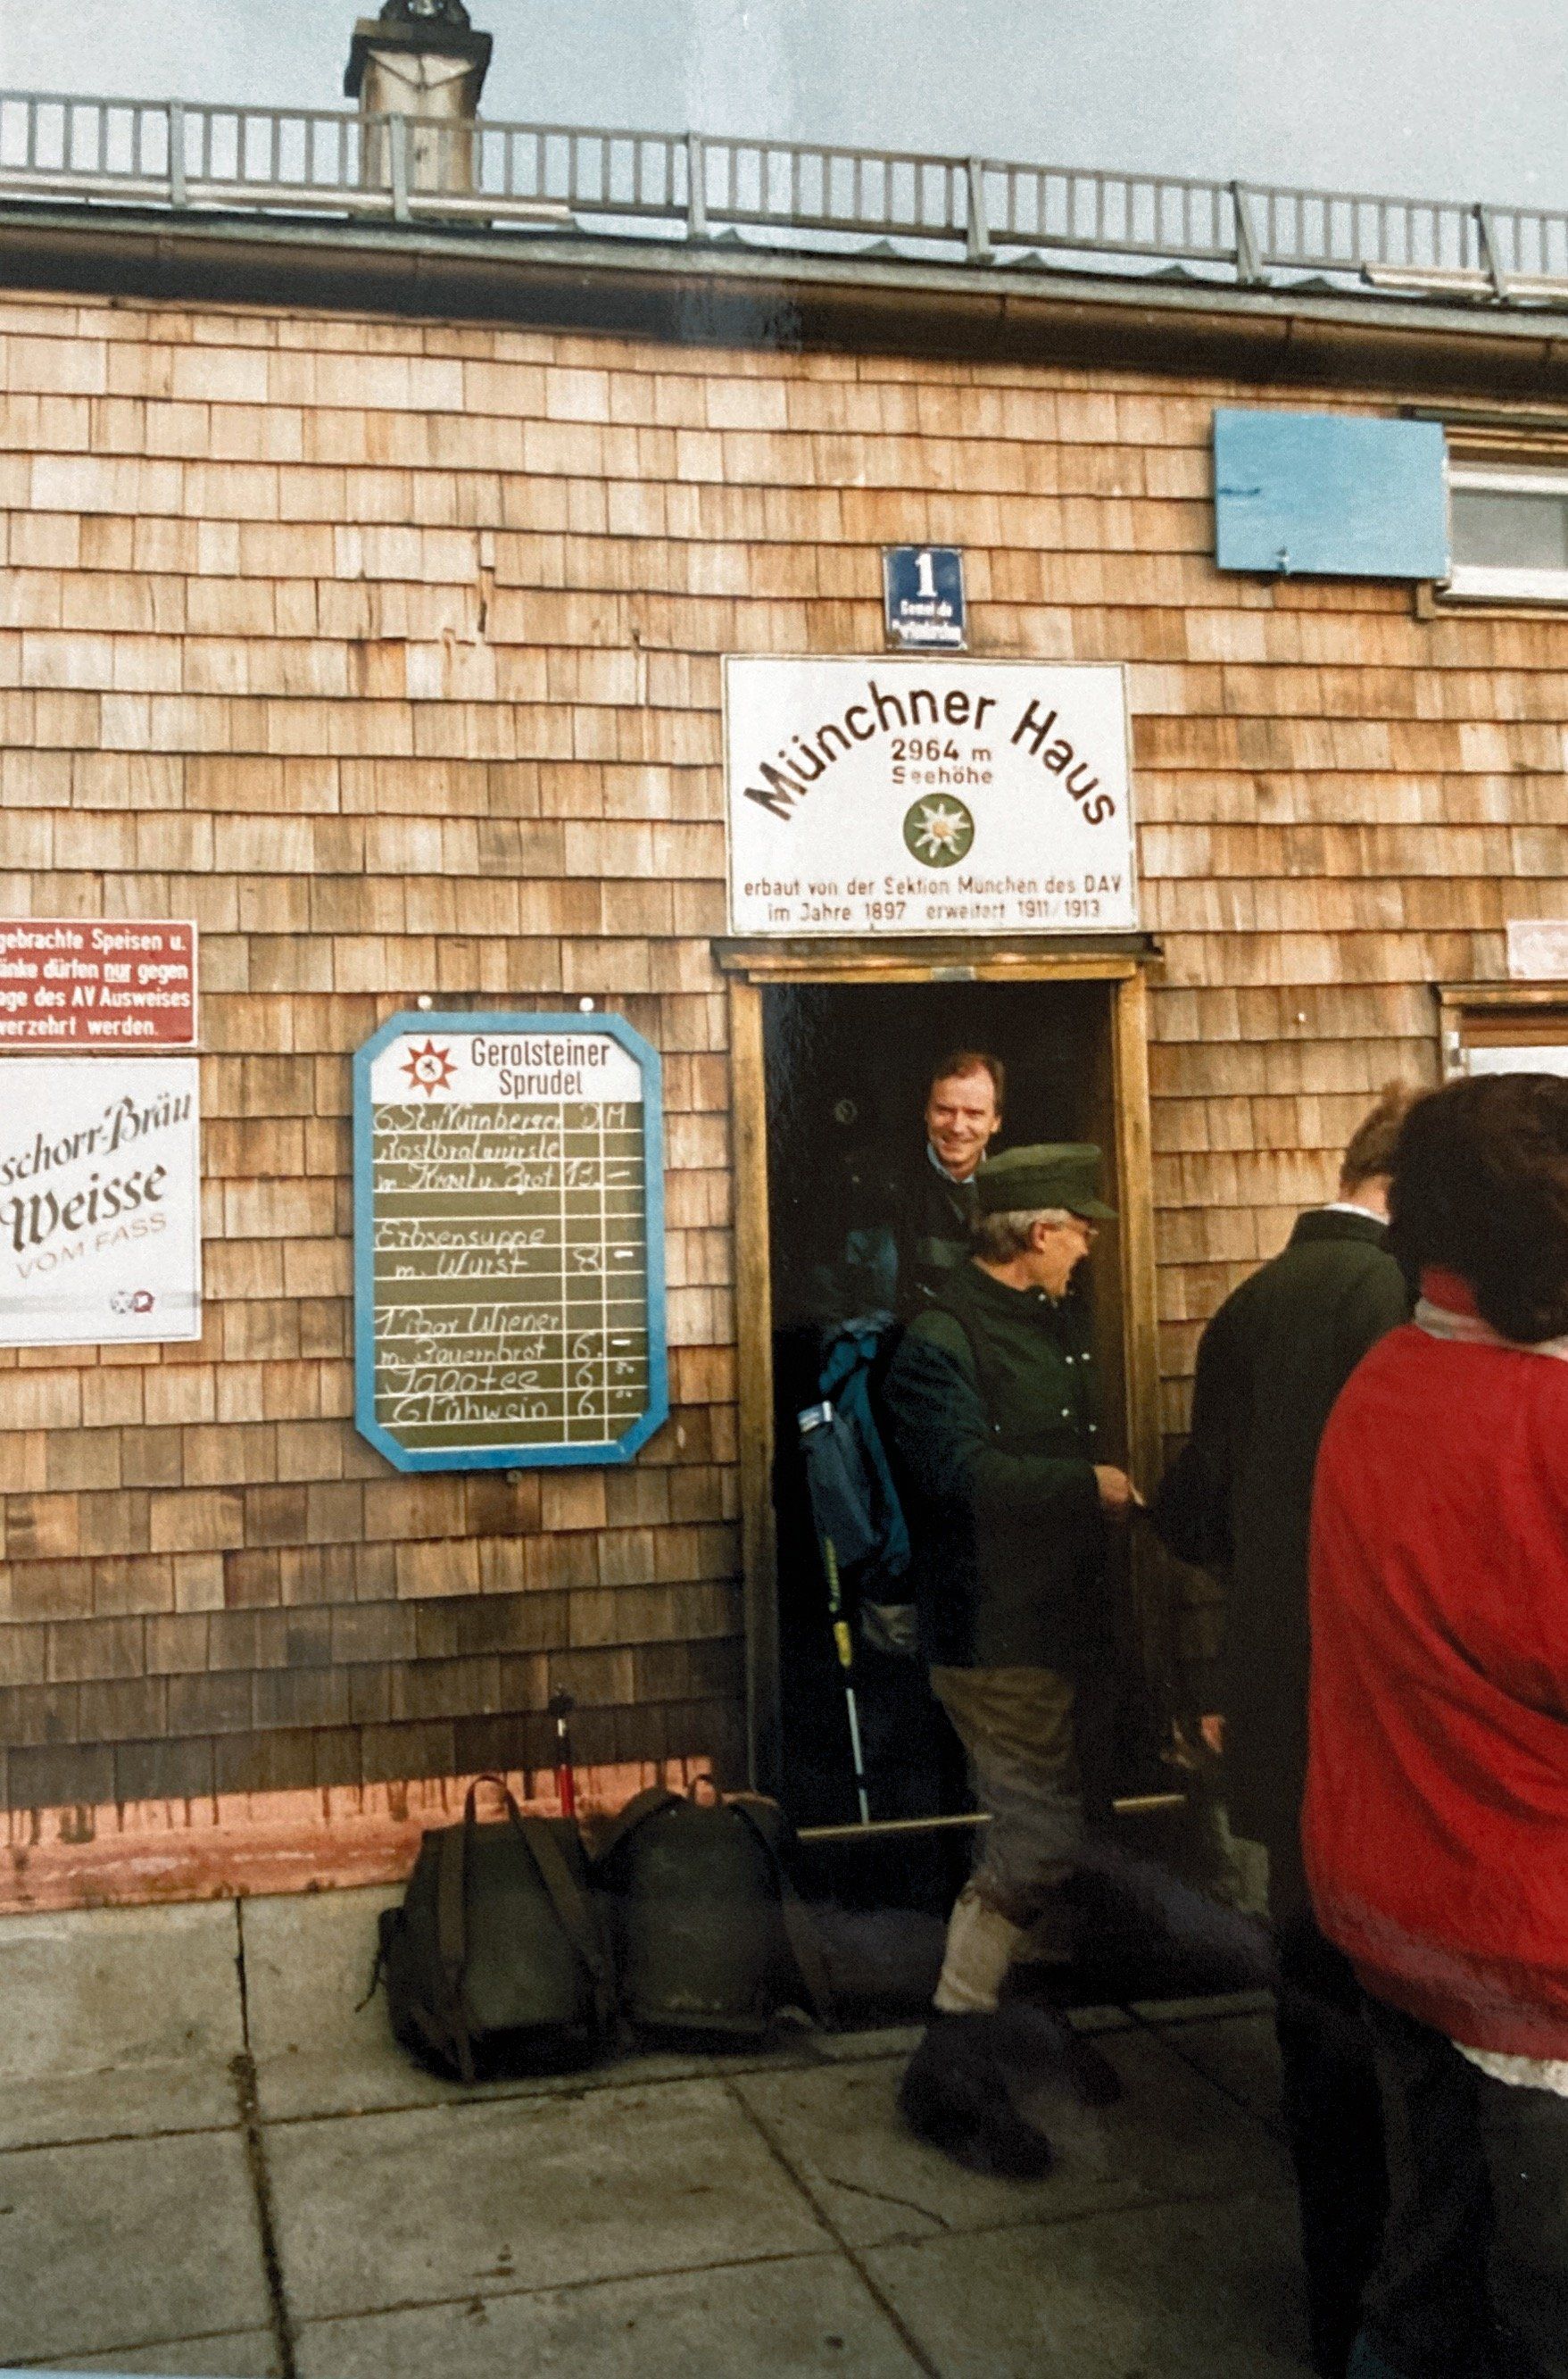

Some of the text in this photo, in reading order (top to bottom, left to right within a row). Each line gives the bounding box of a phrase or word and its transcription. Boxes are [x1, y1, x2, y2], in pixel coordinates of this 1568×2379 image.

[915, 553, 938, 597] 1
[743, 680, 1116, 826] Münchner Haus
[892, 738, 991, 761] 2964 m
[892, 765, 992, 784] Seehöhe
[744, 878, 800, 896] erbaut
[809, 881, 838, 894] von
[847, 878, 875, 895] der
[884, 876, 950, 894] Sektion
[1045, 877, 1075, 894] des
[1084, 874, 1122, 893] DAV
[767, 903, 791, 921] im
[801, 903, 852, 921] Jahre
[865, 901, 906, 920] 1897
[91, 927, 162, 955] Speisen
[170, 935, 187, 951] u.
[44, 958, 99, 979] dürfen
[104, 963, 132, 983] nur
[137, 964, 188, 985] gegen
[34, 986, 66, 1007] des
[72, 986, 95, 1007] AV
[99, 986, 191, 1008] Ausweises
[471, 1036, 610, 1067] Gerolsteiner
[499, 1069, 583, 1100] Sprudel
[0, 1164, 167, 1252] Weisse
[16, 1212, 167, 1279] VOM FASS
[437, 1251, 528, 1277] Wurst
